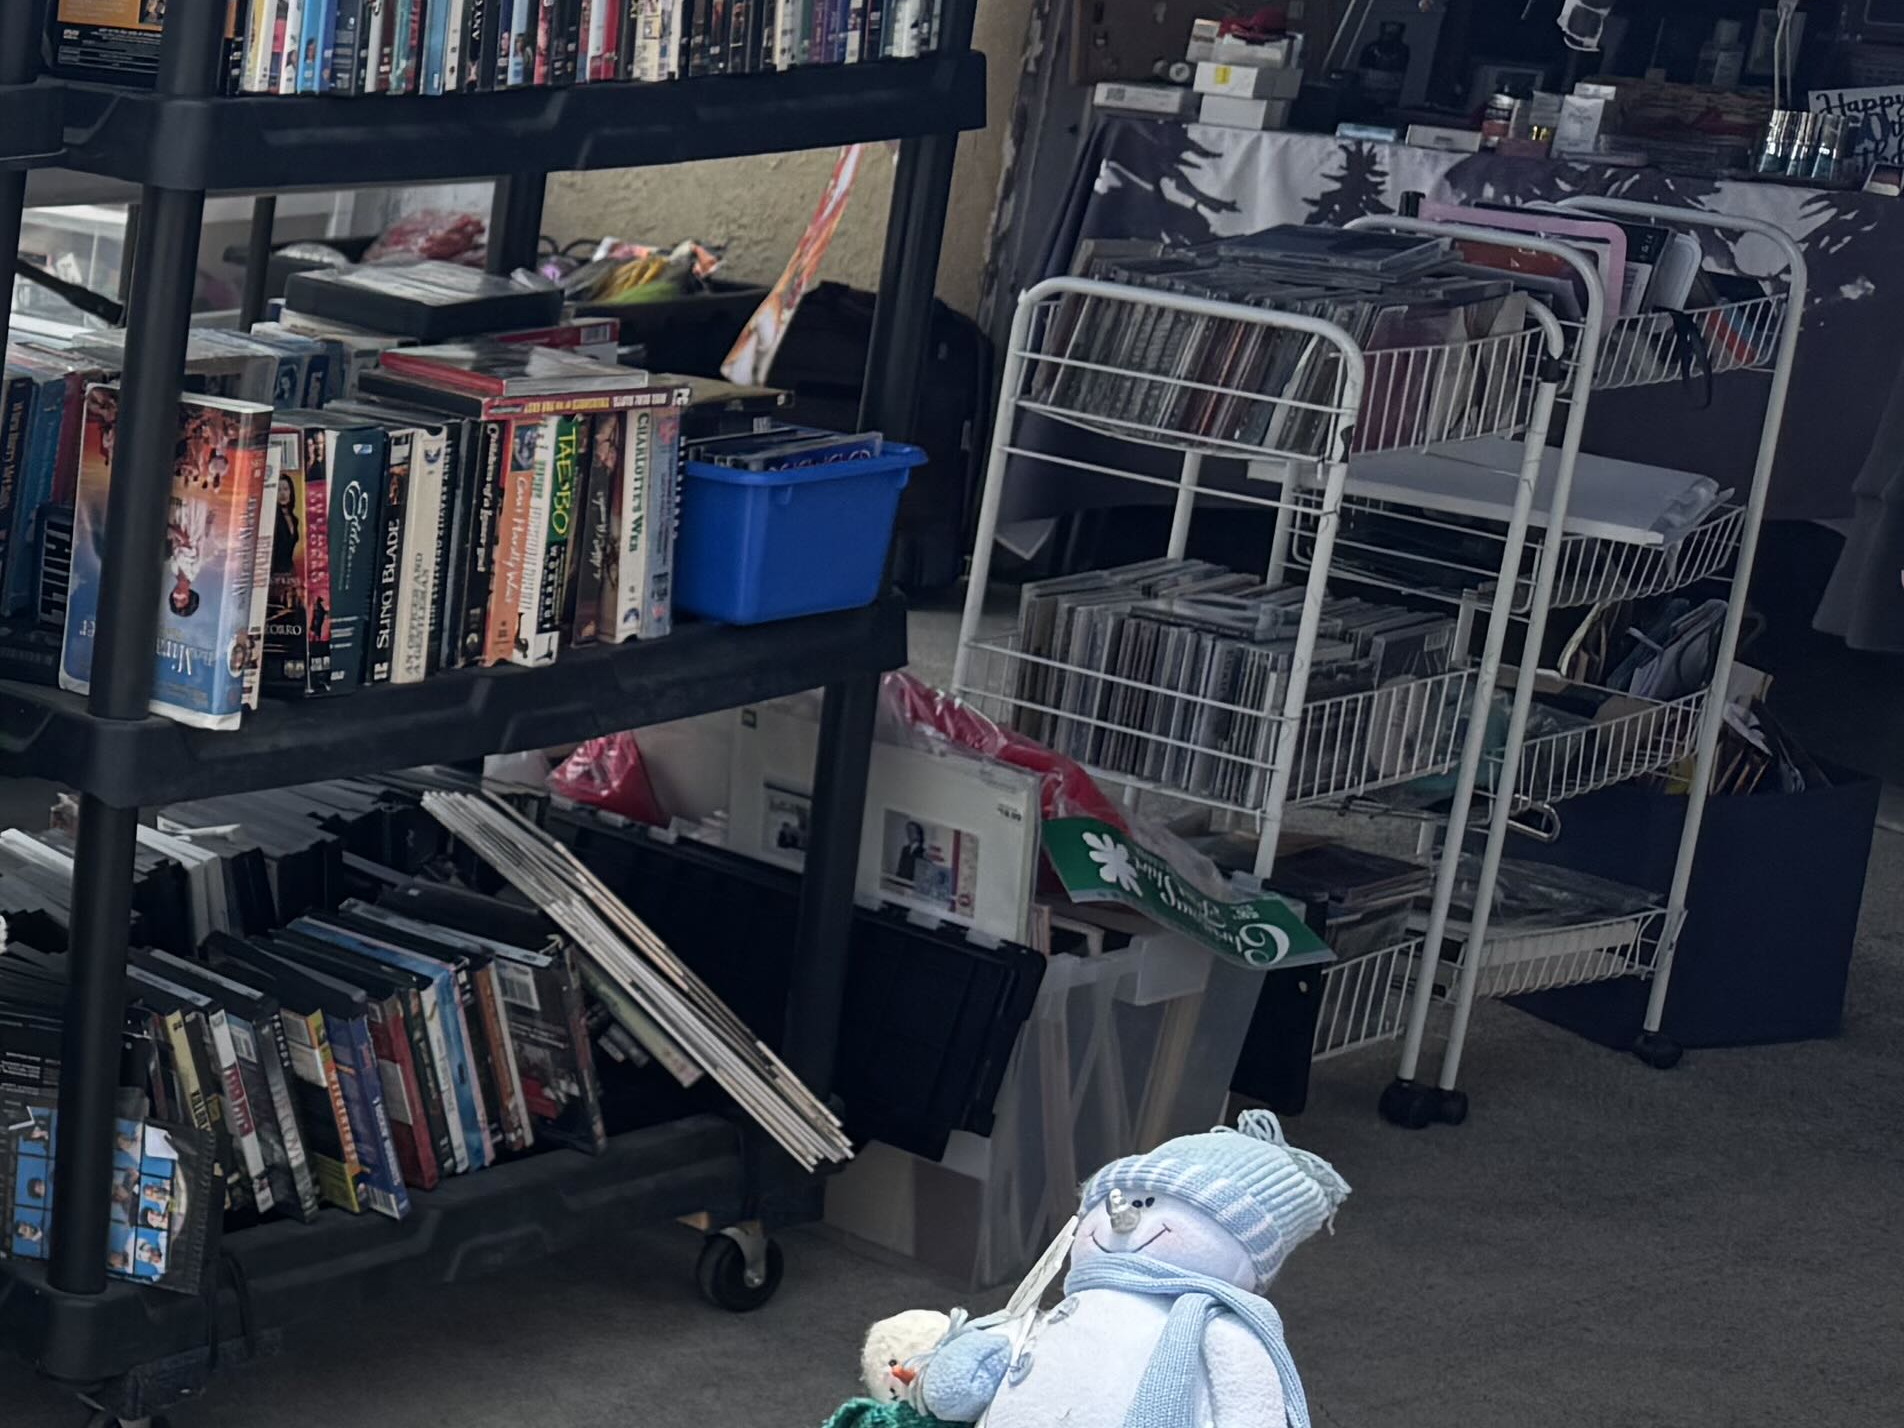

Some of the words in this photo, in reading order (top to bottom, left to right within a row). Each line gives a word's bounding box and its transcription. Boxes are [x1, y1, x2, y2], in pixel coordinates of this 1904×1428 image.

[472, 8, 484, 41] ANY
[381, 518, 403, 583] BLADE
[263, 622, 302, 636] ORRO
[376, 588, 395, 649] SLING
[155, 636, 193, 676] Mira
